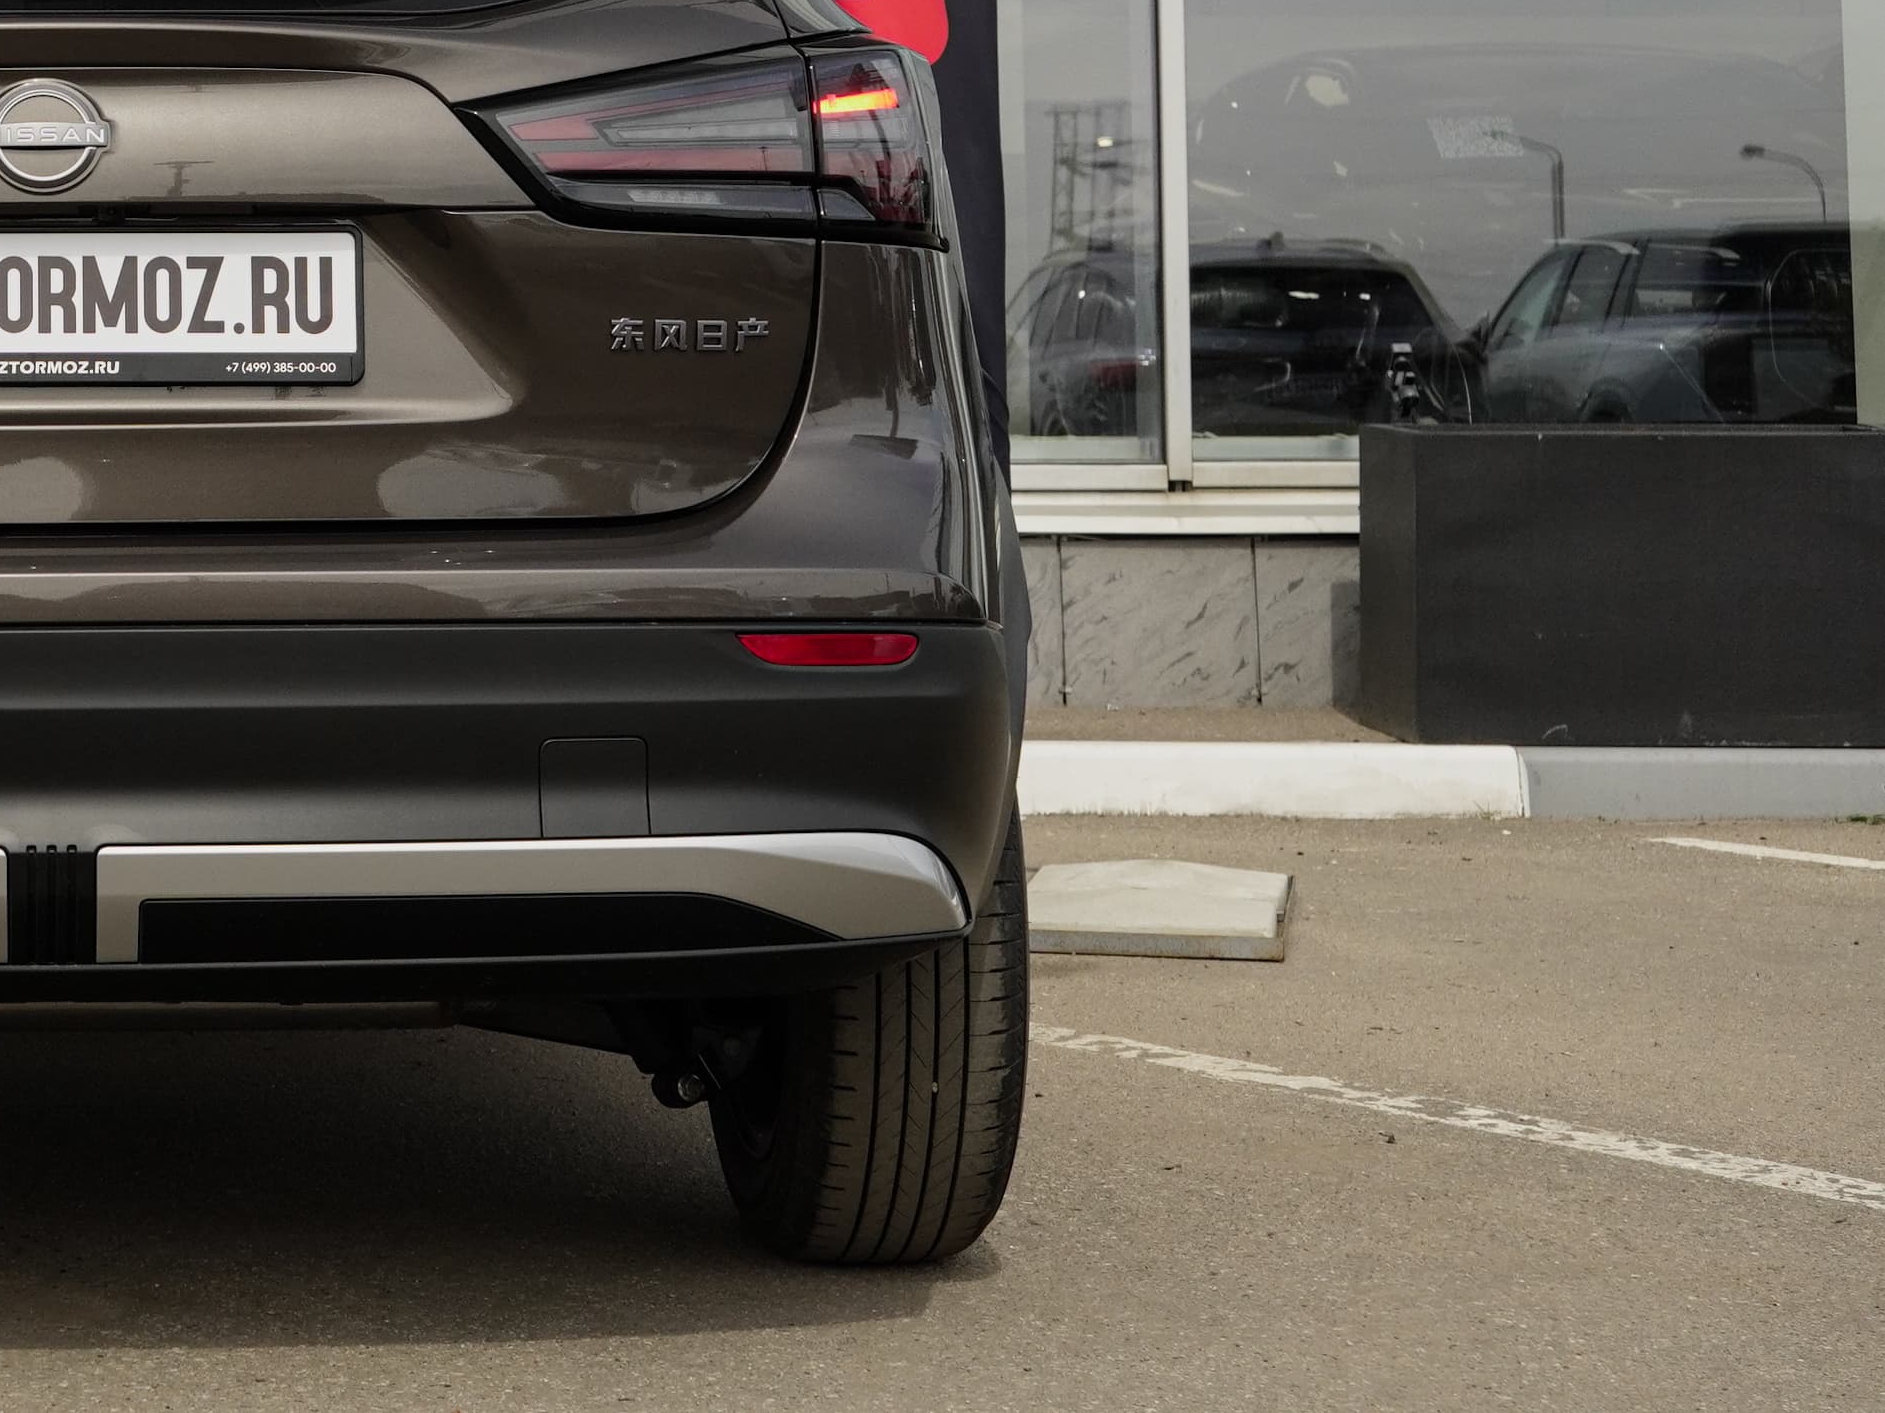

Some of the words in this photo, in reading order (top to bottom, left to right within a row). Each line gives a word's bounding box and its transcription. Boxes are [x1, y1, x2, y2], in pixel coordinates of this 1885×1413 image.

[610, 317, 769, 352] 东风日产
[225, 362, 239, 373] +7
[241, 361, 271, 375] (499)
[273, 362, 337, 374] 385-00-00
